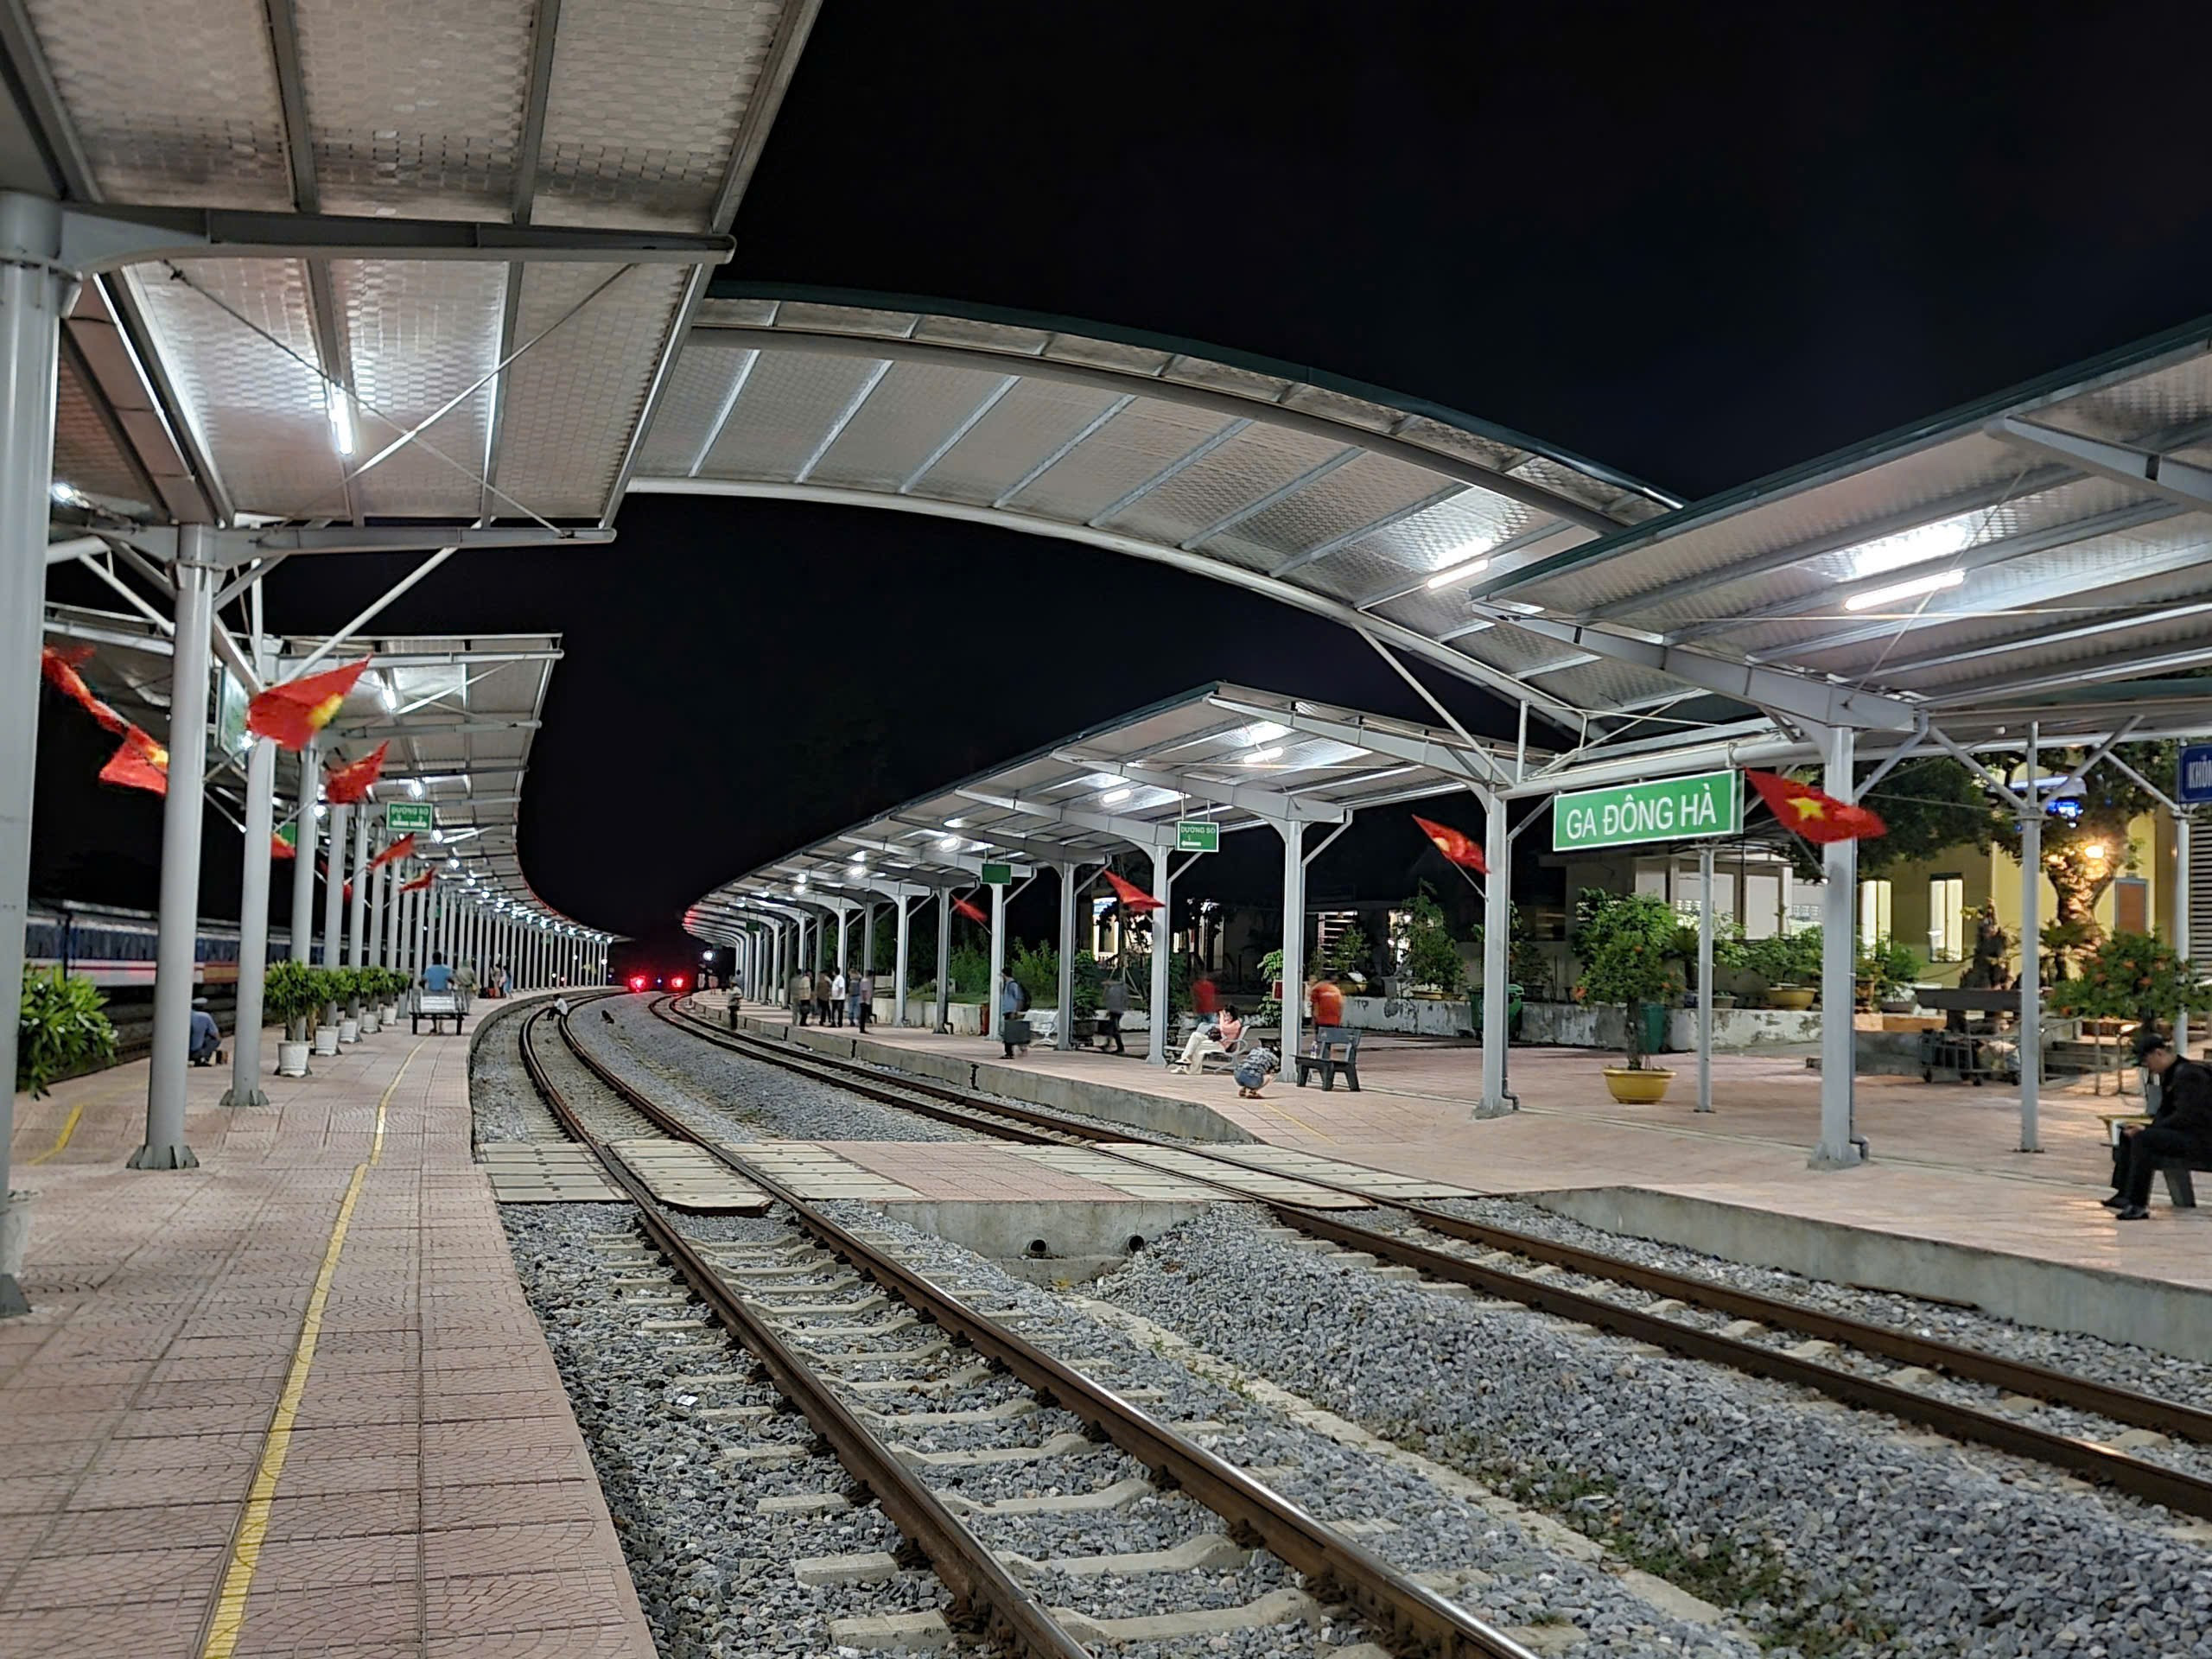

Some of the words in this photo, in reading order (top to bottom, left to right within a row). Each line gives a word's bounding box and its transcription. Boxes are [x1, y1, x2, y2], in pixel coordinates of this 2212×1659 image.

[1566, 808, 1597, 840] GA
[1603, 793, 1674, 836] ĐÔNG
[1681, 783, 1717, 827] HÀ
